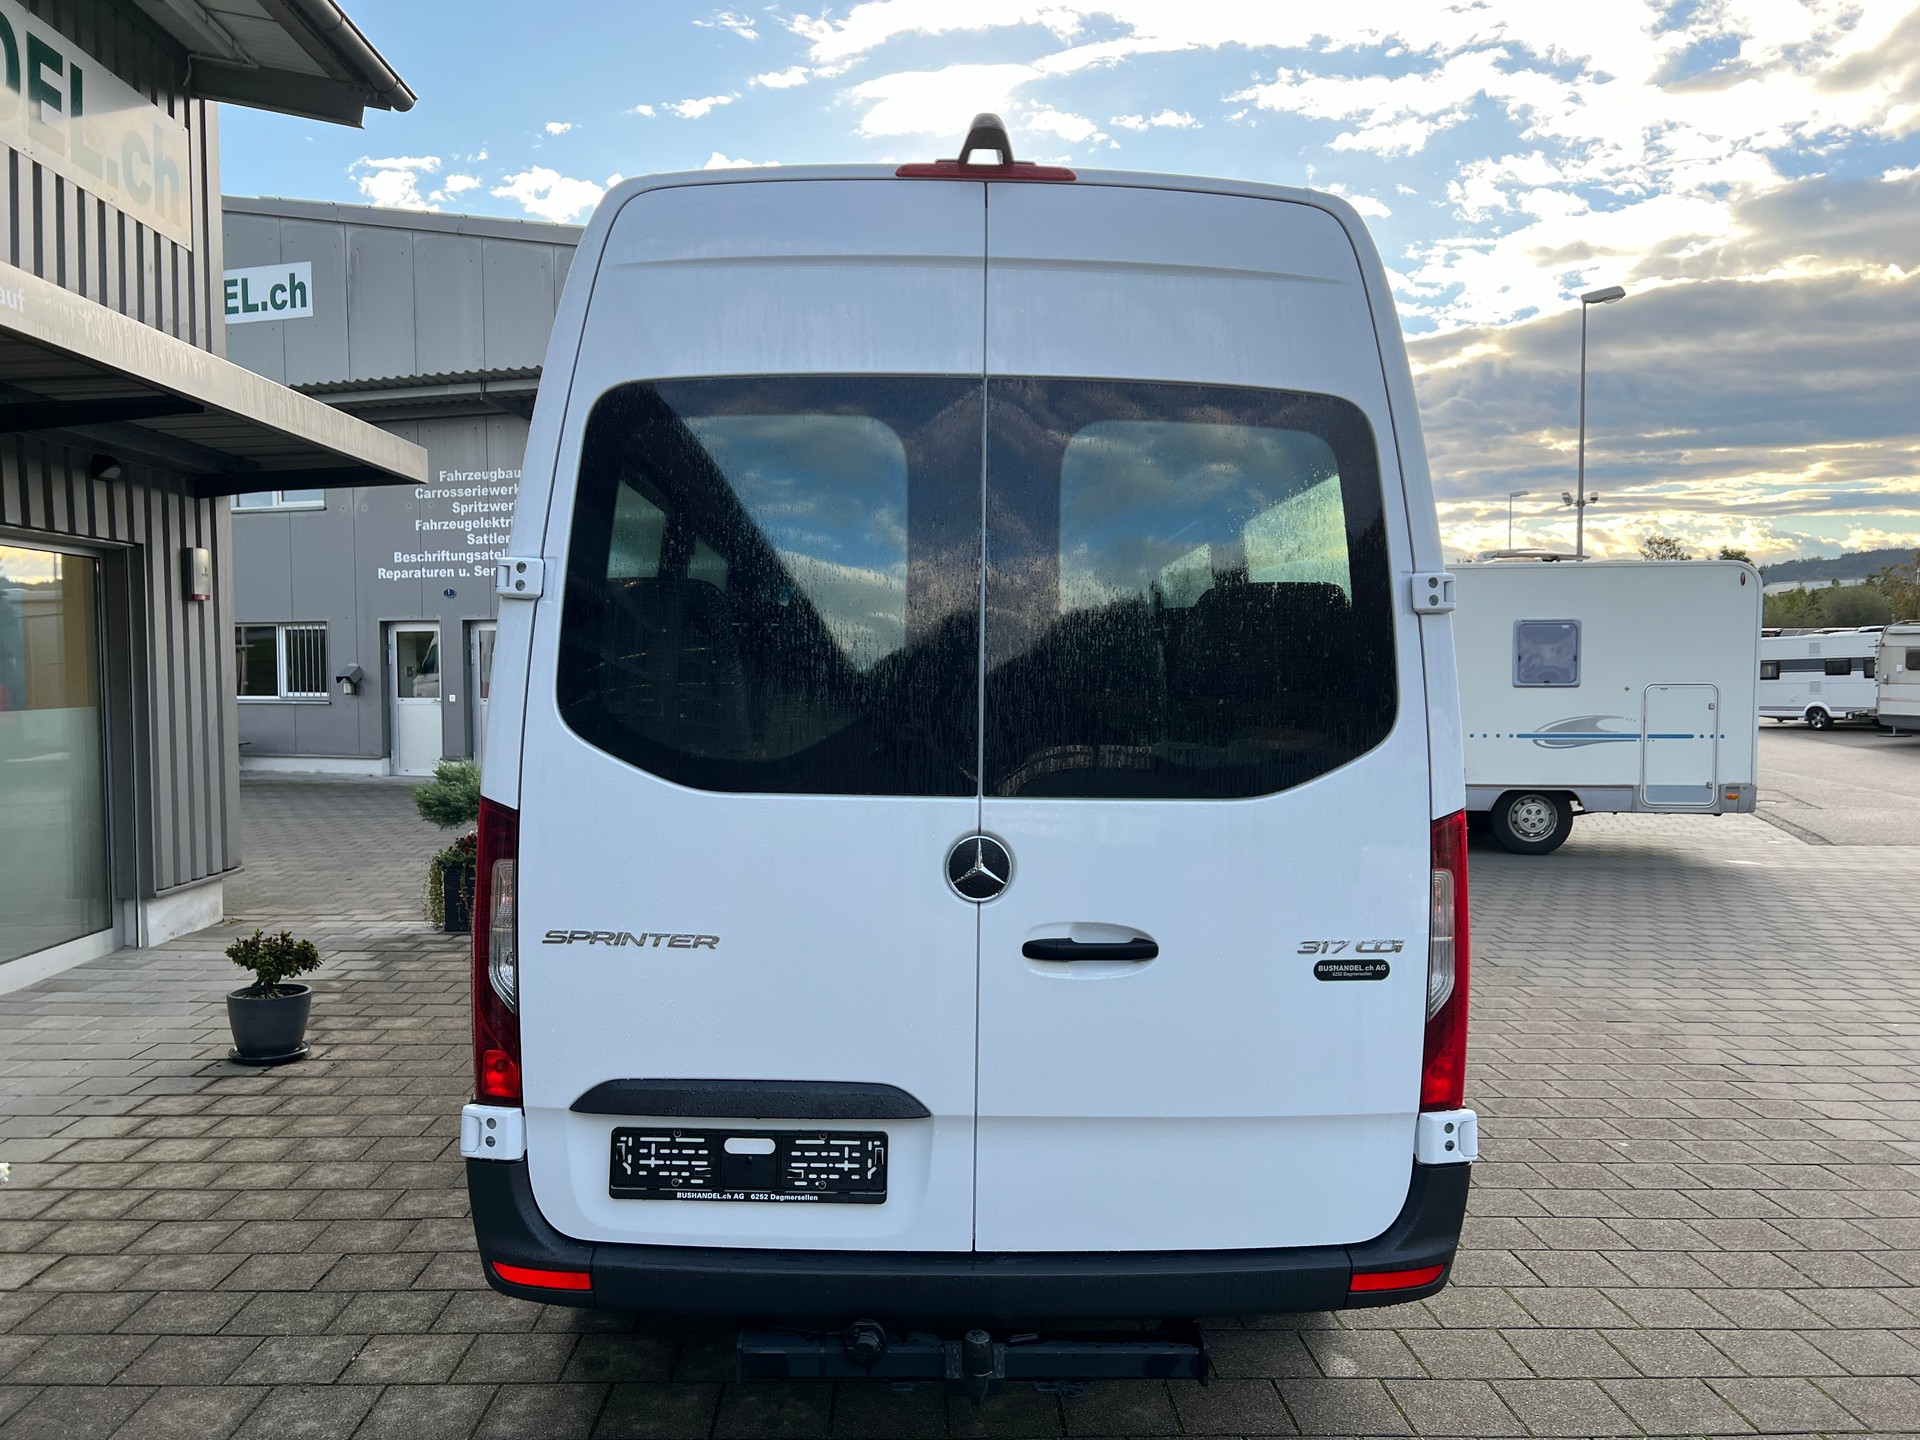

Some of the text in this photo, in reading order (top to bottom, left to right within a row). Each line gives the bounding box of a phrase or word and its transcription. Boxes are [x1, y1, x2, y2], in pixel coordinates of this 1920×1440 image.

[439, 468, 521, 482] Fahrzeugbau
[452, 500, 517, 515] Spritzwer
[377, 567, 455, 581] Reparaturen
[458, 569, 470, 577] u.
[541, 929, 720, 950] SPRINTER
[1297, 940, 1350, 954] 317
[676, 1191, 732, 1200] BUSHANDEL.ch
[733, 1192, 745, 1200] AG
[770, 1193, 819, 1202] Dagmersellen
